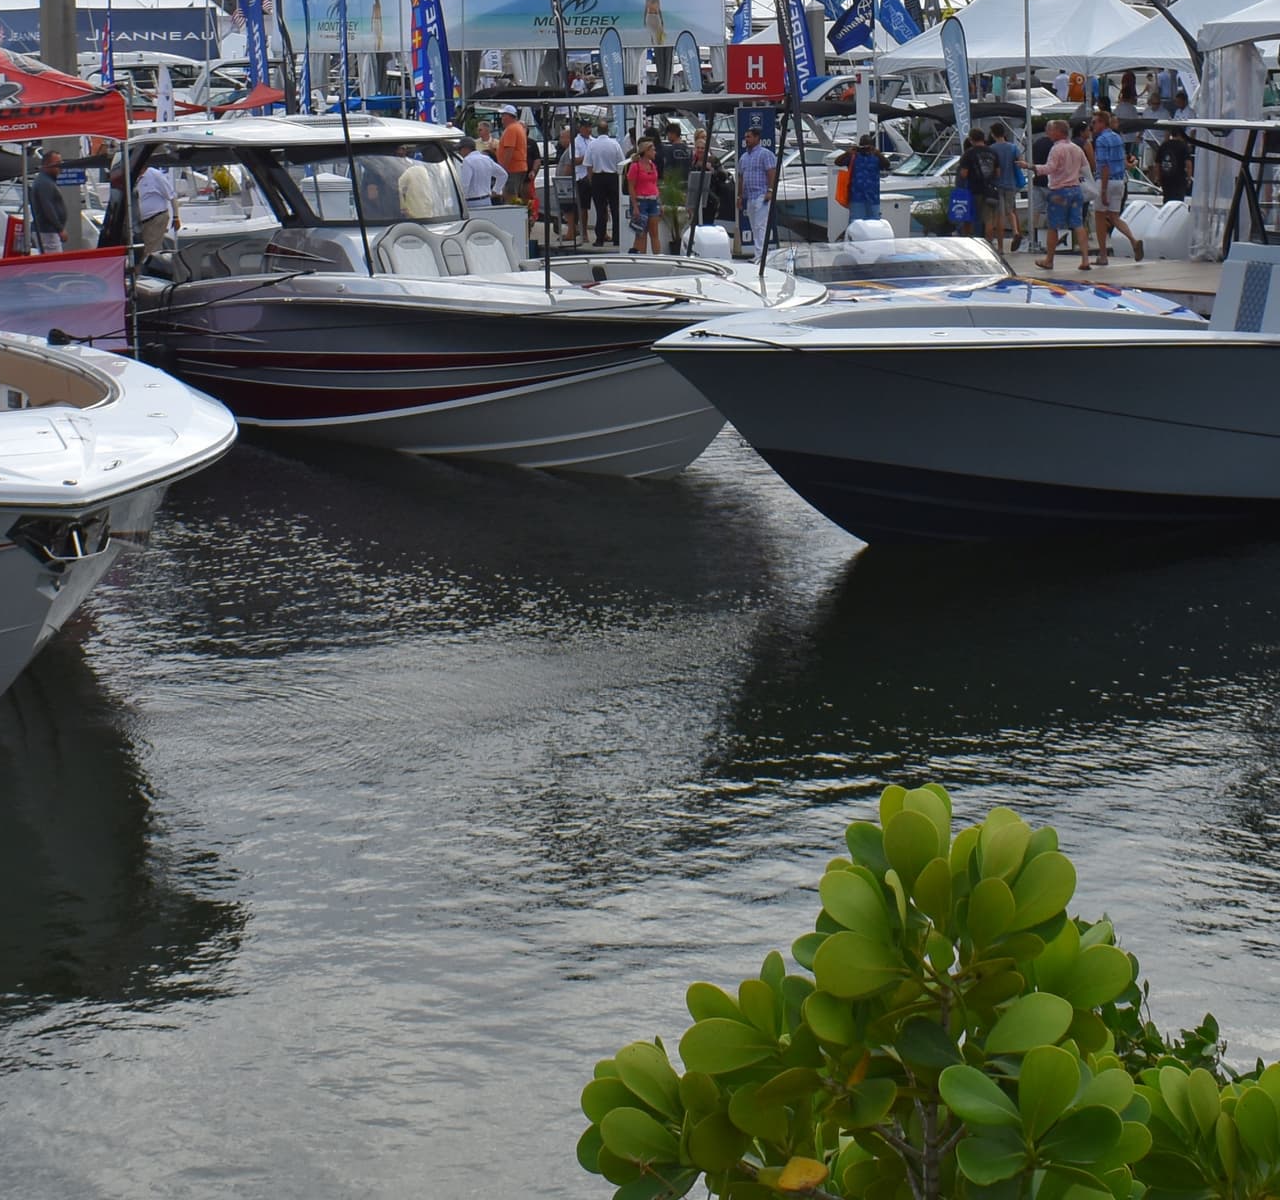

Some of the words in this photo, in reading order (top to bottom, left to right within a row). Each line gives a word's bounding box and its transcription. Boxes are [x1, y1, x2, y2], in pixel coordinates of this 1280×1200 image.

[317, 22, 358, 31] MONTEY
[575, 27, 609, 36] BOAT
[748, 55, 763, 78] H
[745, 82, 767, 90] DOCK
